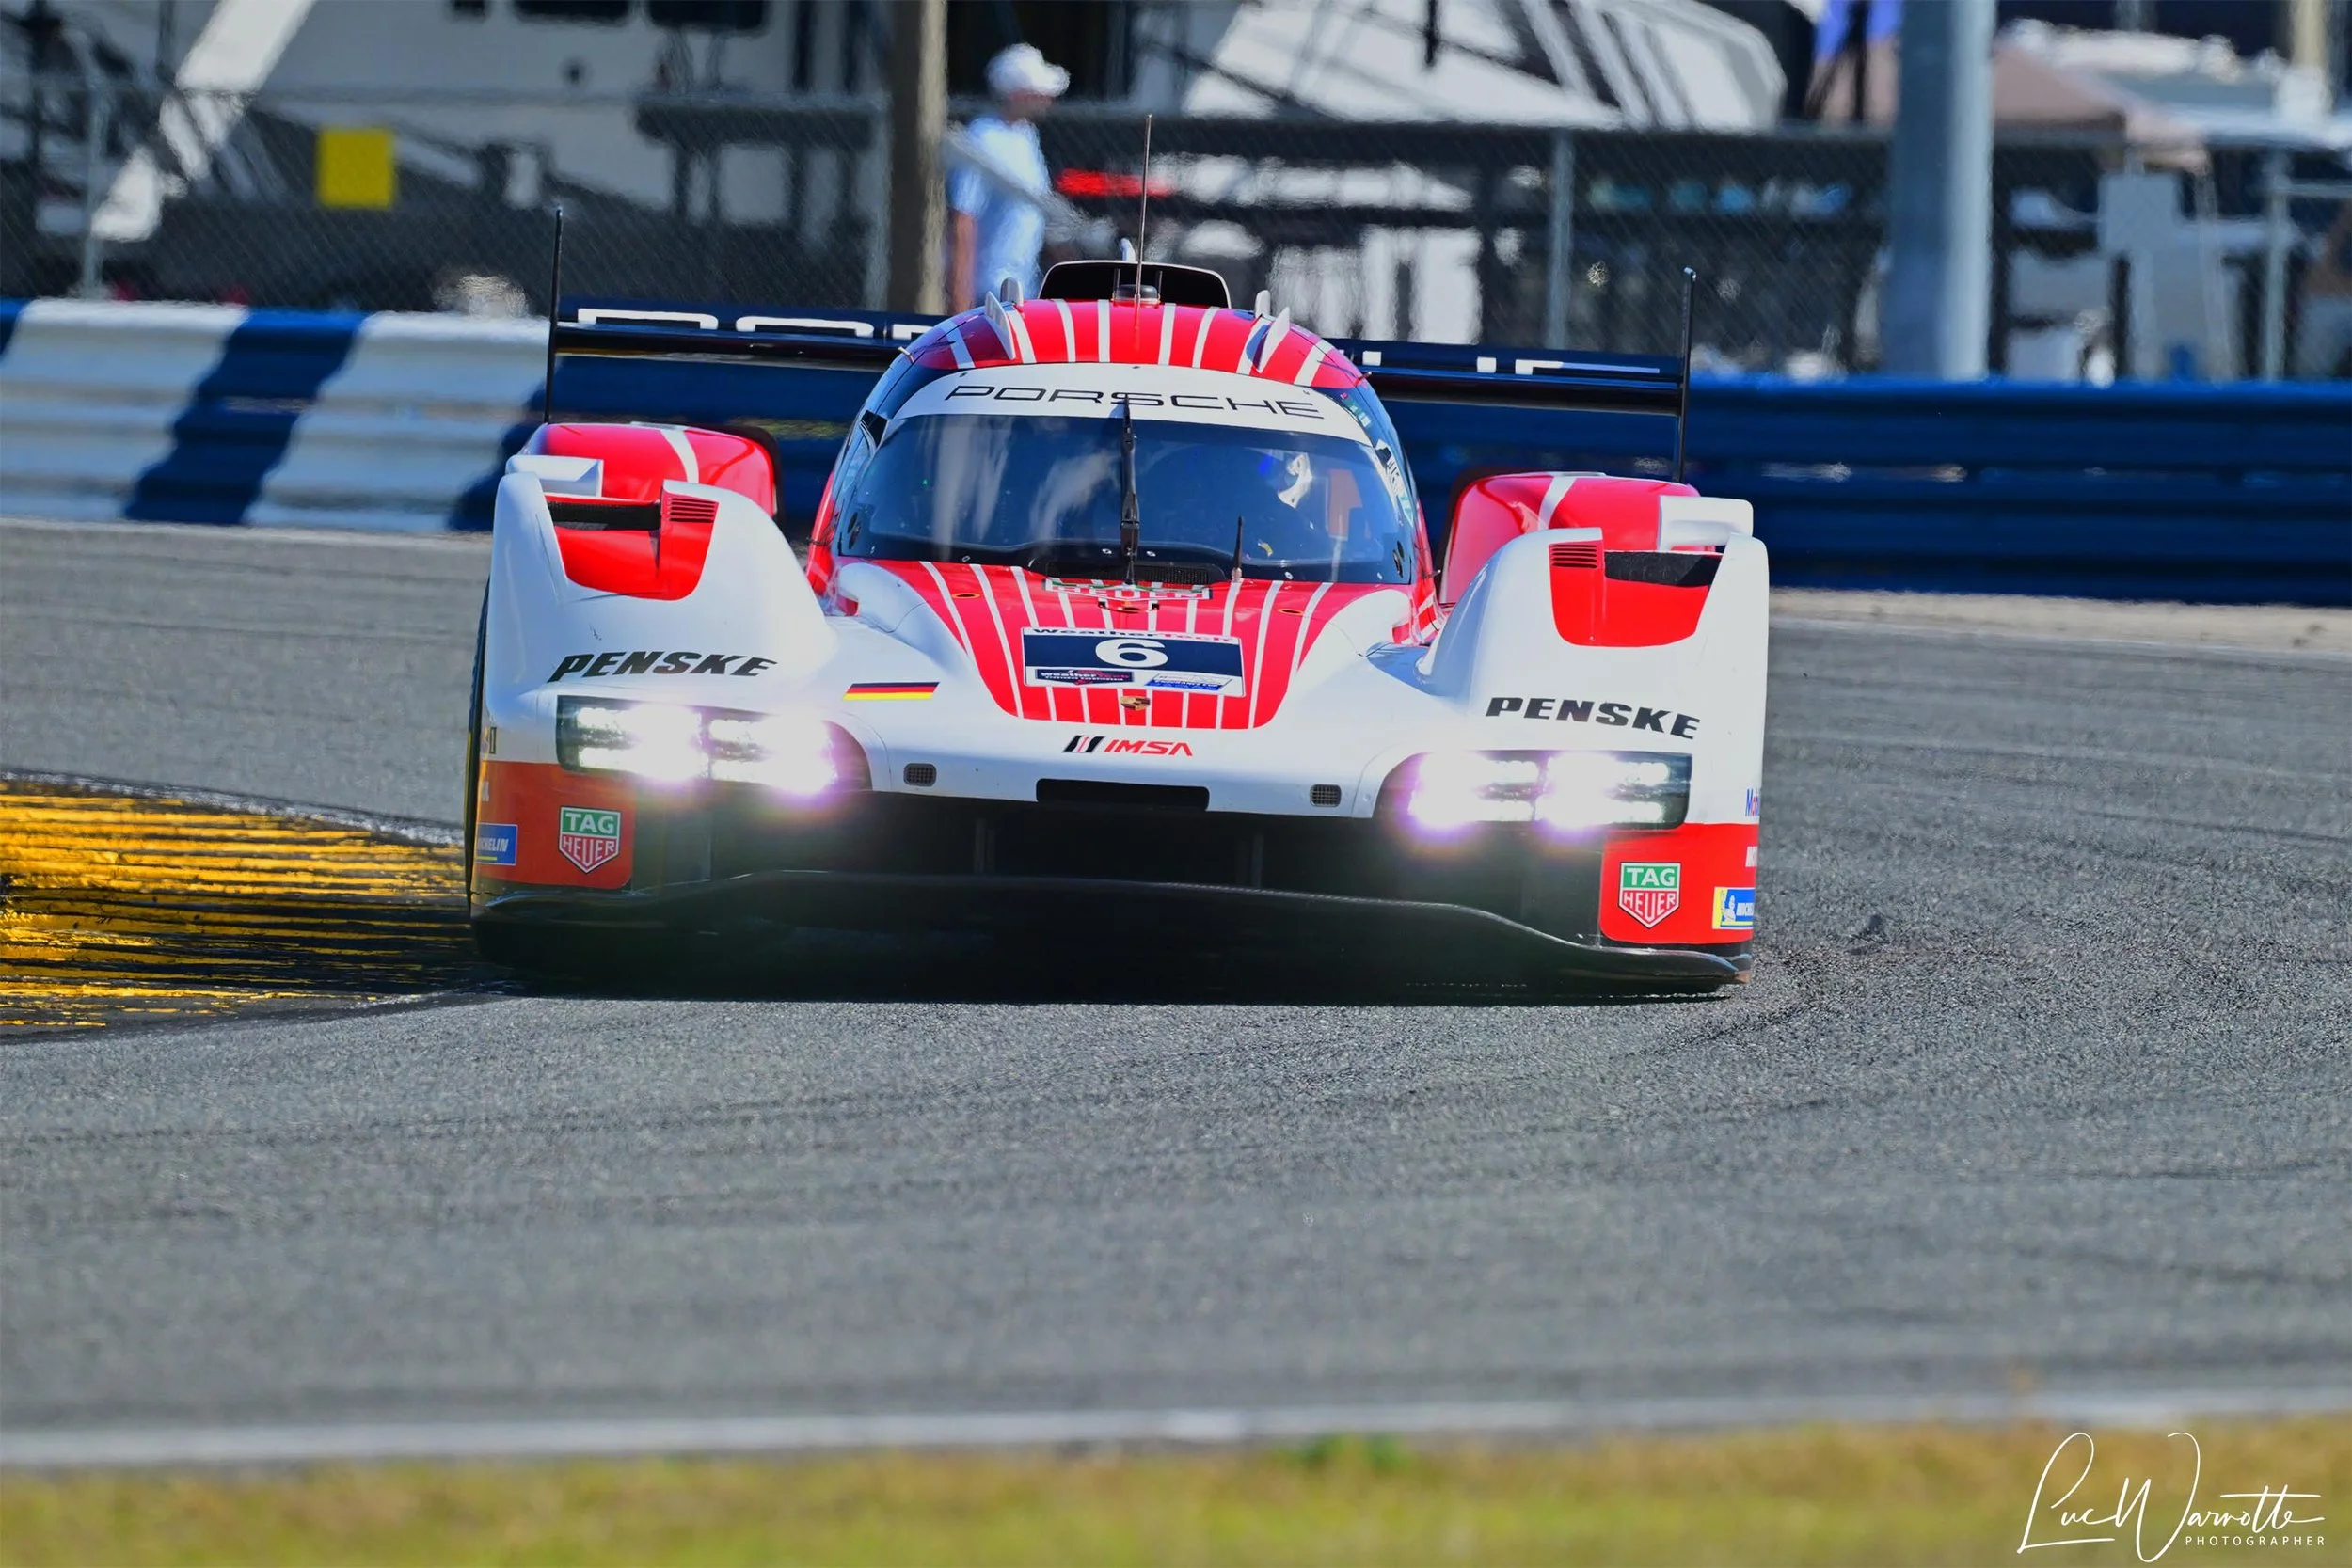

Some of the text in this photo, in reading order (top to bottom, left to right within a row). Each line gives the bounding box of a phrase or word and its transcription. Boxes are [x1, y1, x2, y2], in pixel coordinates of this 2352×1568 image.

[945, 386, 1324, 420] PORSCHE
[548, 651, 778, 683] PENSKE
[1095, 639, 1168, 668] 6
[1486, 697, 1701, 739] PENSKE
[1104, 739, 1193, 756] IMSA
[565, 812, 615, 835] TAG
[563, 835, 616, 865] HEUER
[1626, 867, 1676, 887] TAG
[1623, 890, 1677, 921] HEUER
